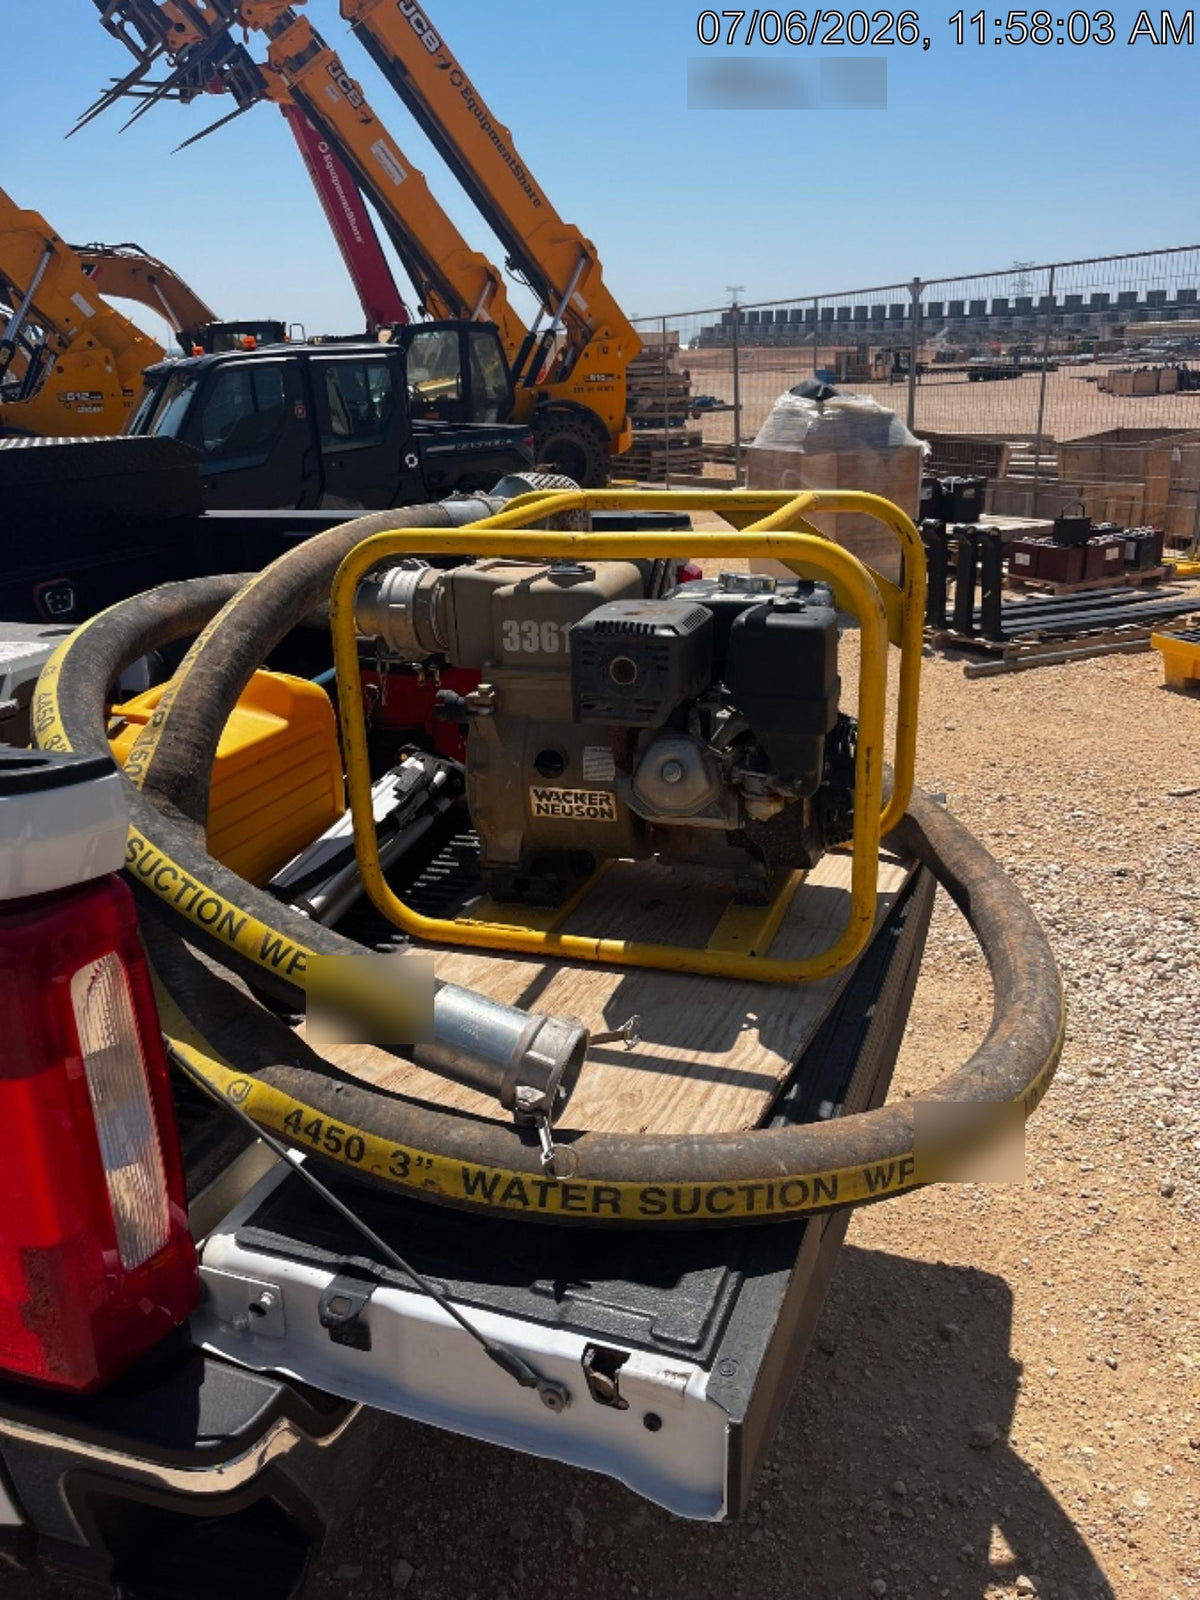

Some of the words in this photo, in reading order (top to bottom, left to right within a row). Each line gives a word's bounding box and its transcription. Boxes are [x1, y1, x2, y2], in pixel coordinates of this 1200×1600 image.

[397, 0, 441, 54] JCB
[326, 60, 363, 109] JCB
[460, 85, 542, 209] EquipmentShare
[532, 788, 612, 806] WACKER
[536, 803, 615, 819] NEUSON
[125, 838, 247, 942] SUCTION
[283, 1109, 366, 1164] 4450
[461, 1165, 622, 1215] WATER
[638, 1174, 839, 1215] SUCTION
